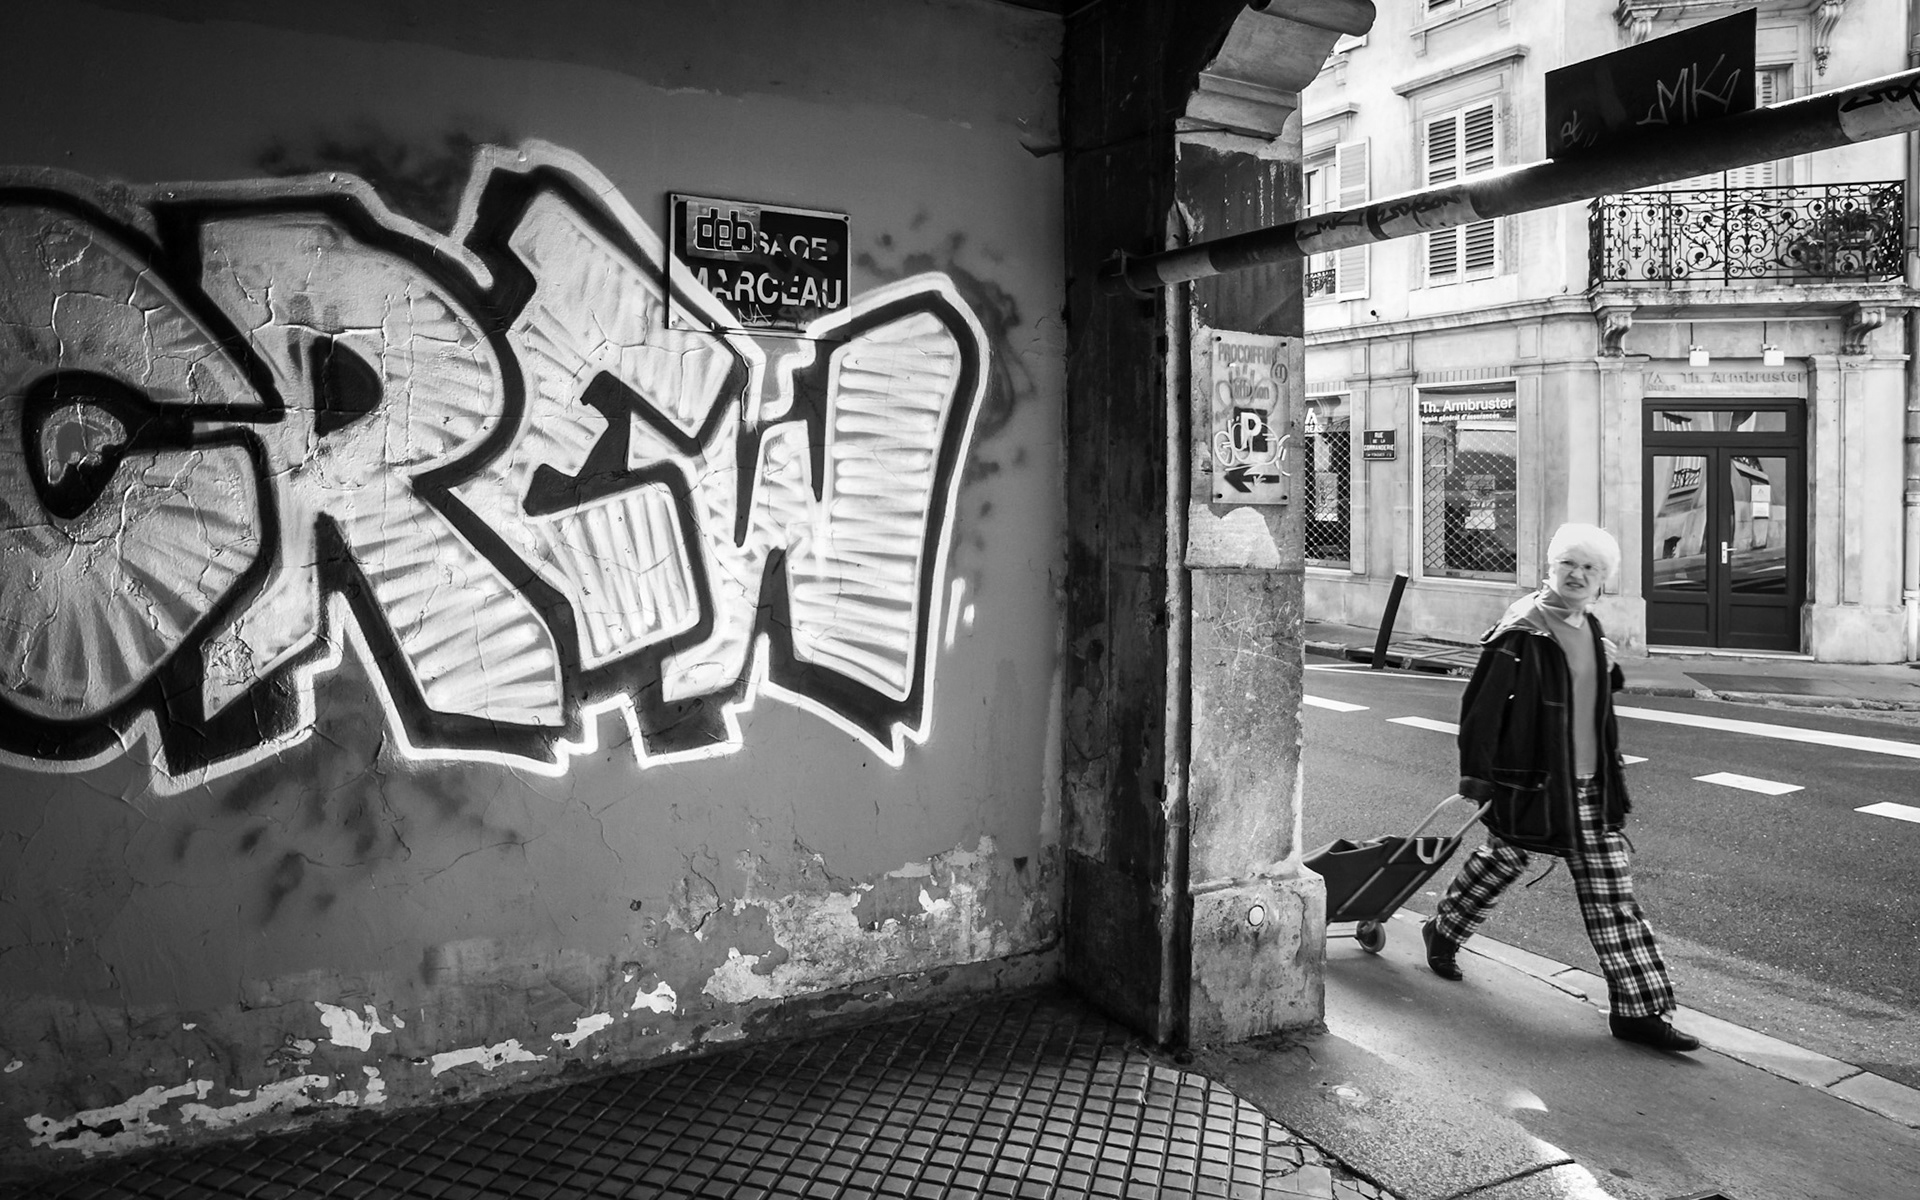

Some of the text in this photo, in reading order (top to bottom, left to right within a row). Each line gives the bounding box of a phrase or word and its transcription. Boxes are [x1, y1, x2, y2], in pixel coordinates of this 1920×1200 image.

[1711, 370, 1804, 384] Armbruster
[1421, 398, 1514, 414] Th. Armbruster
[1304, 424, 1324, 433] REAS
